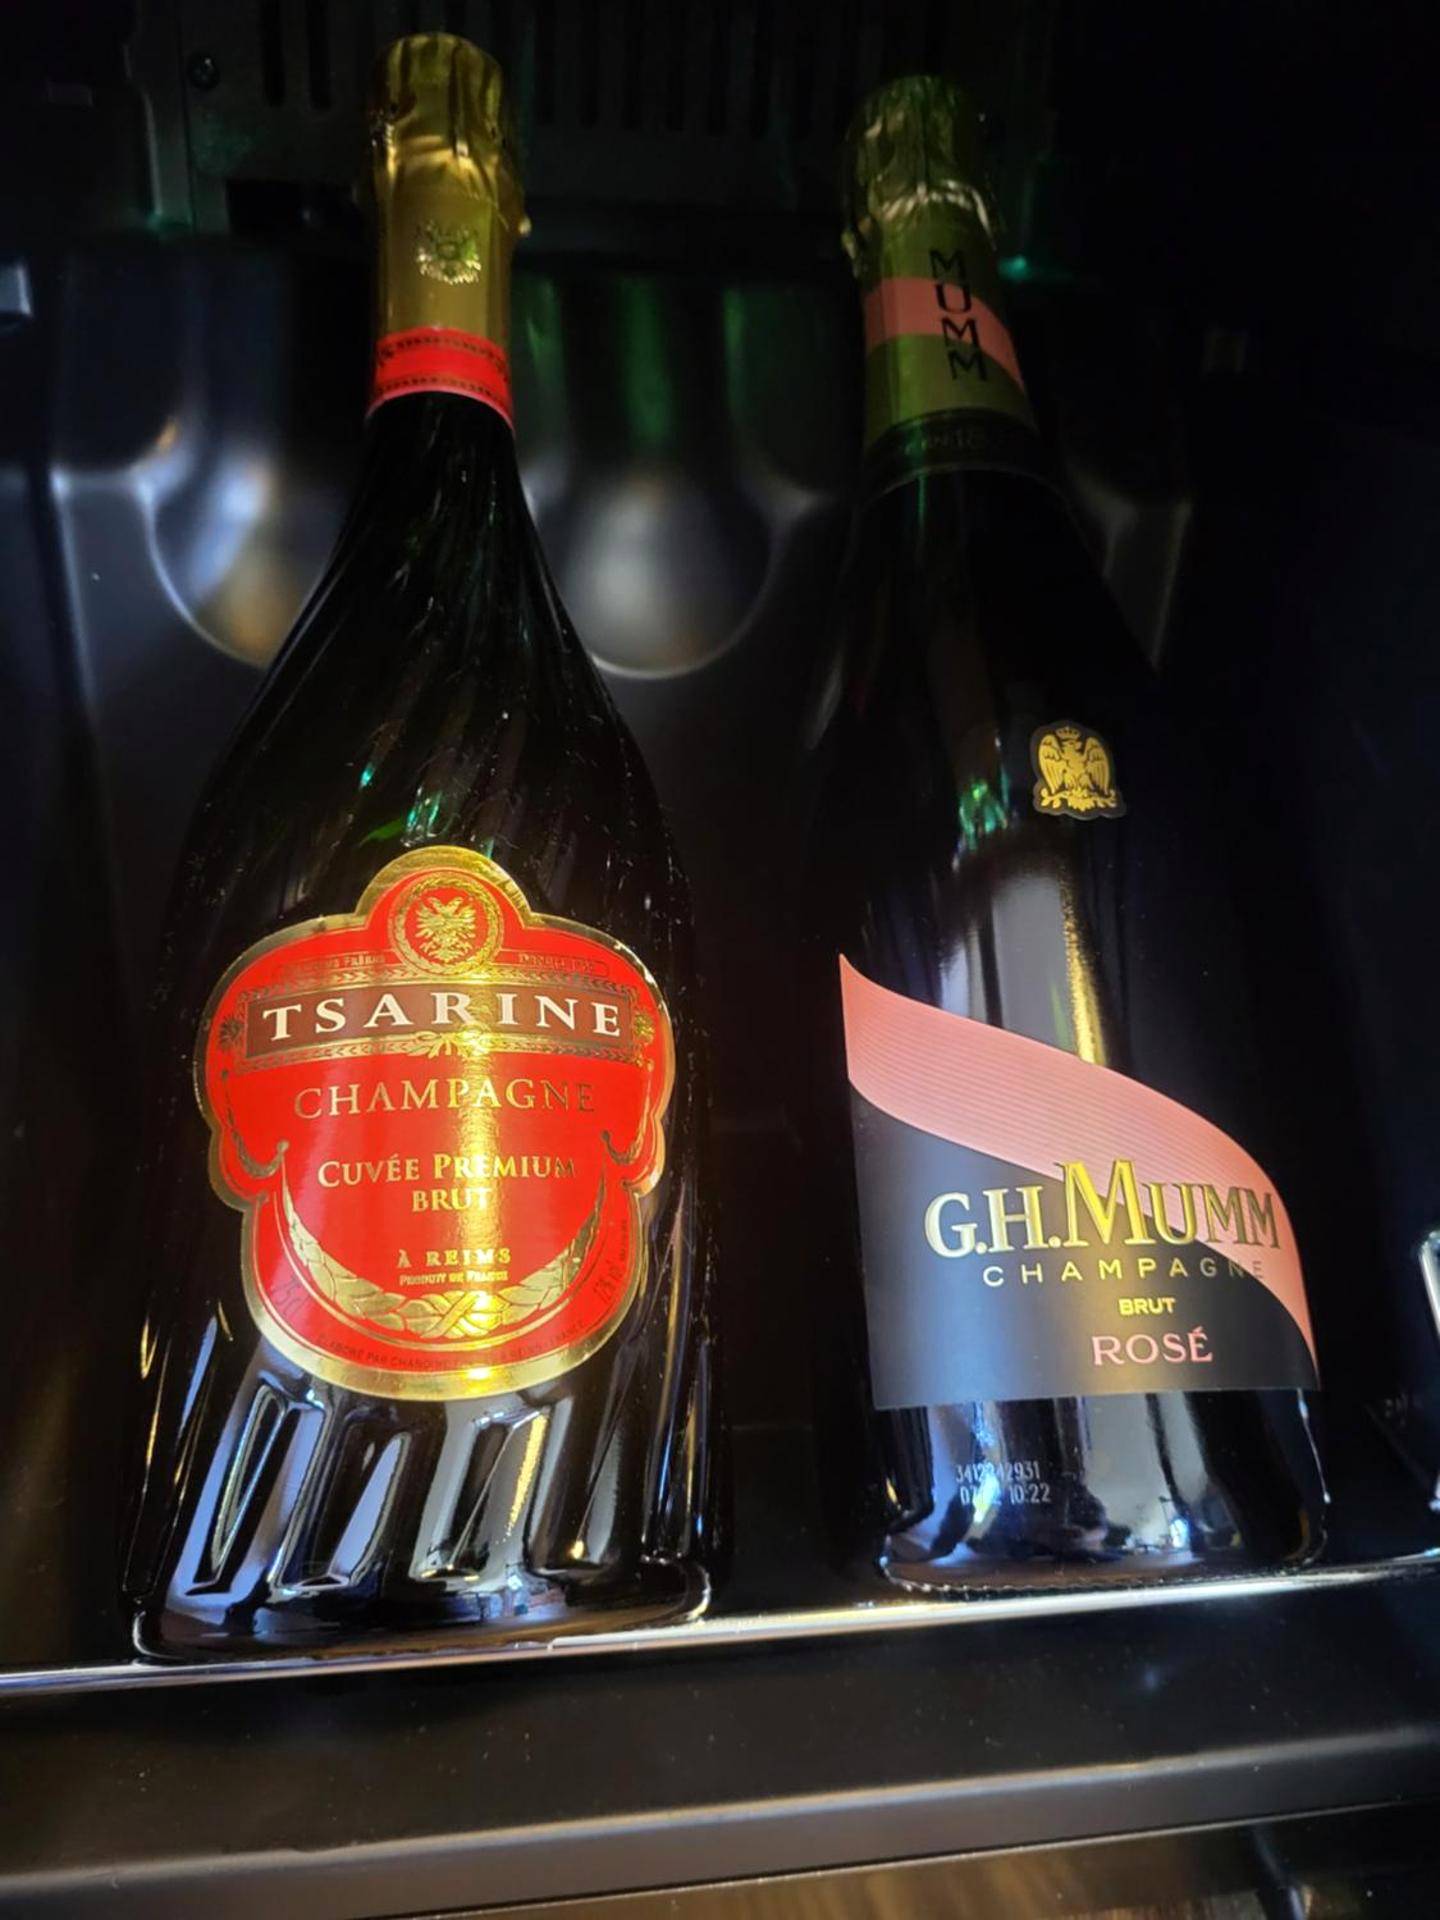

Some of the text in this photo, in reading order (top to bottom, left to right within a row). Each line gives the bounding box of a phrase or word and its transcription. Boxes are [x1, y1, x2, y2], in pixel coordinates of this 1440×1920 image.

[929, 249, 988, 382] MUMM
[262, 991, 621, 1042] TSARINE
[293, 1078, 595, 1120] CHAMPAGNE
[317, 1153, 420, 1188] CUVÉE
[411, 1186, 494, 1212] BRUT
[426, 1248, 511, 1267] REIMS
[982, 1256, 1264, 1288] CHAMPAGNE
[1118, 1296, 1176, 1317] BRUT
[1090, 1325, 1214, 1367] ROSÉ
